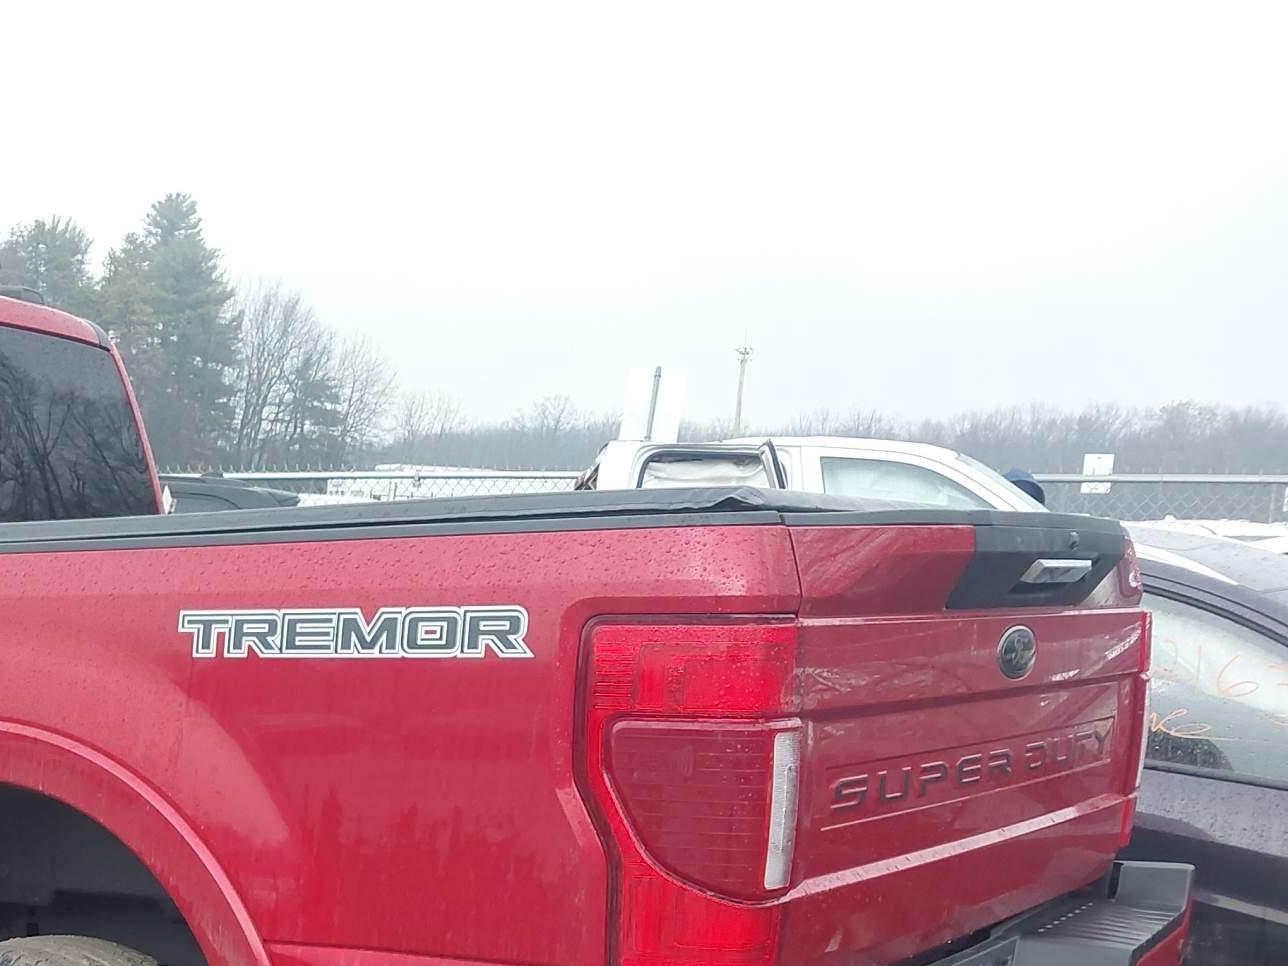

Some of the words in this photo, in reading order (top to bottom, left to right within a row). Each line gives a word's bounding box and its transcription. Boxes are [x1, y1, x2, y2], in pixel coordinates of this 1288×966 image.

[178, 606, 535, 658] TREMOR
[830, 749, 1012, 809] SUPER
[1025, 729, 1111, 769] DUTY
